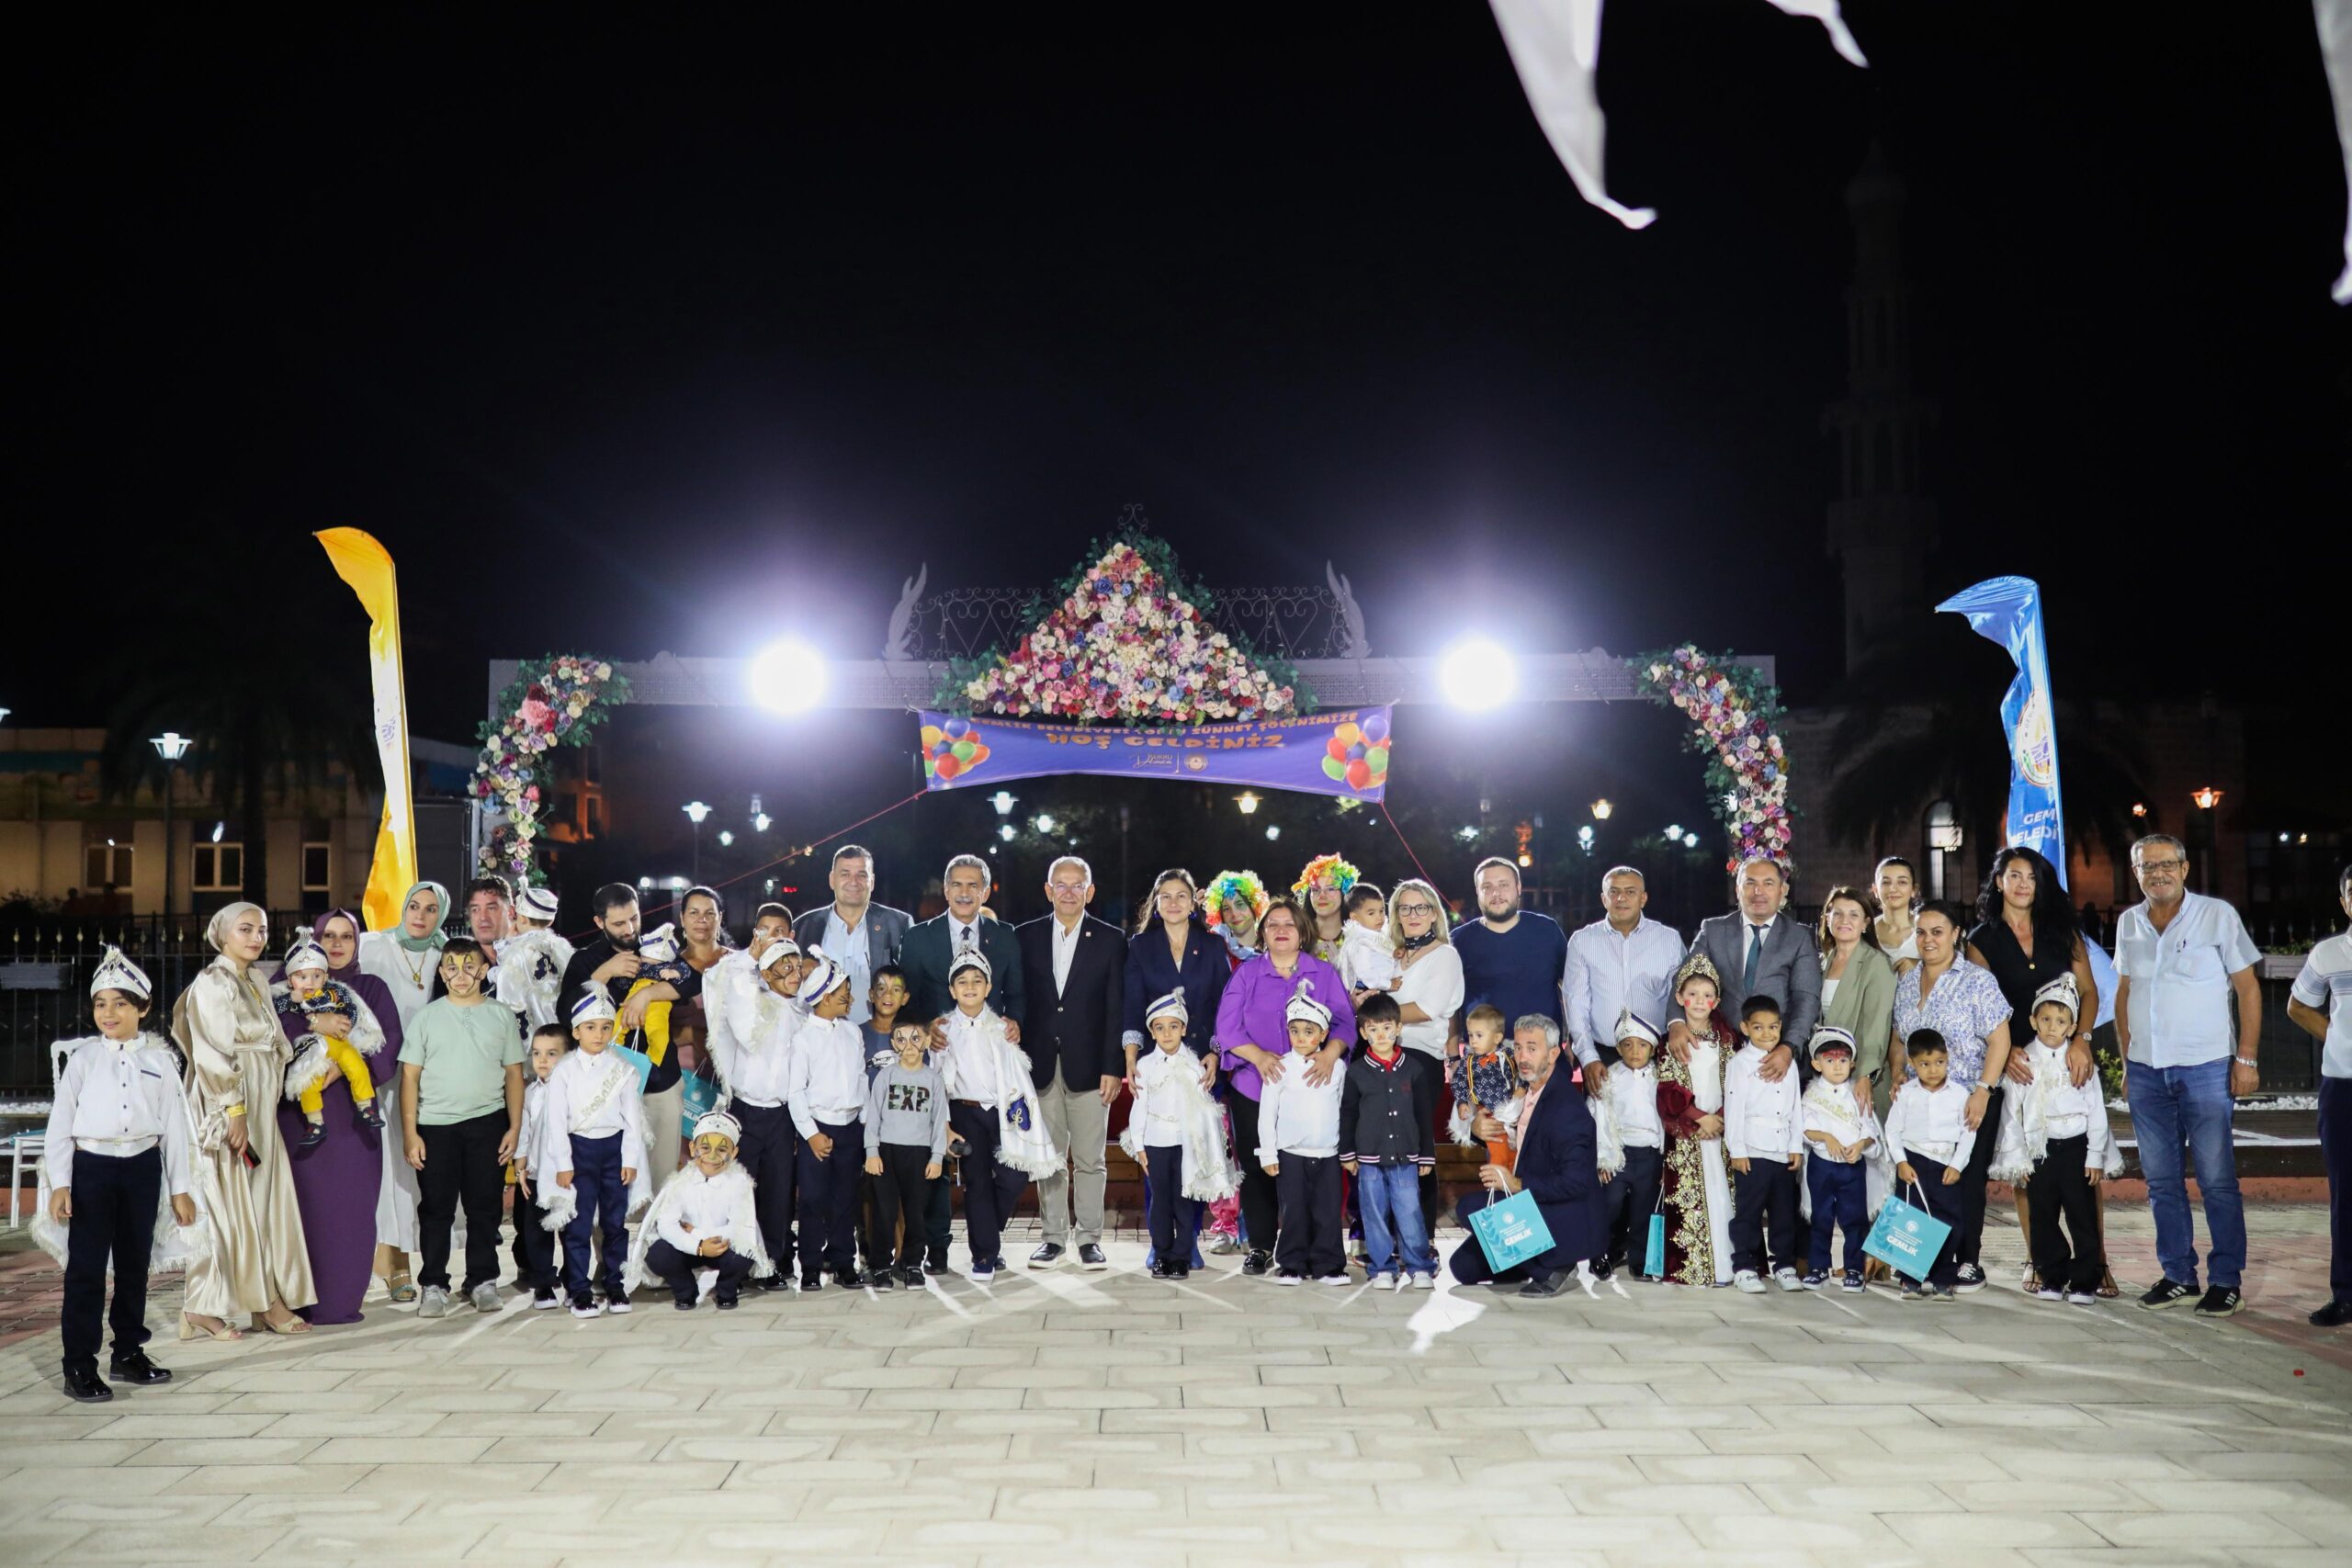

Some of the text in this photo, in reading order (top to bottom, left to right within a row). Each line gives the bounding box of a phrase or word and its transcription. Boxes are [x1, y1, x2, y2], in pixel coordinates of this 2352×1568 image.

[1046, 733, 1284, 750] HOŞ GELDİNİZ
[2023, 808, 2057, 826] GEM
[2012, 824, 2058, 844] ELEDİ
[888, 1084, 929, 1113] EXP.
